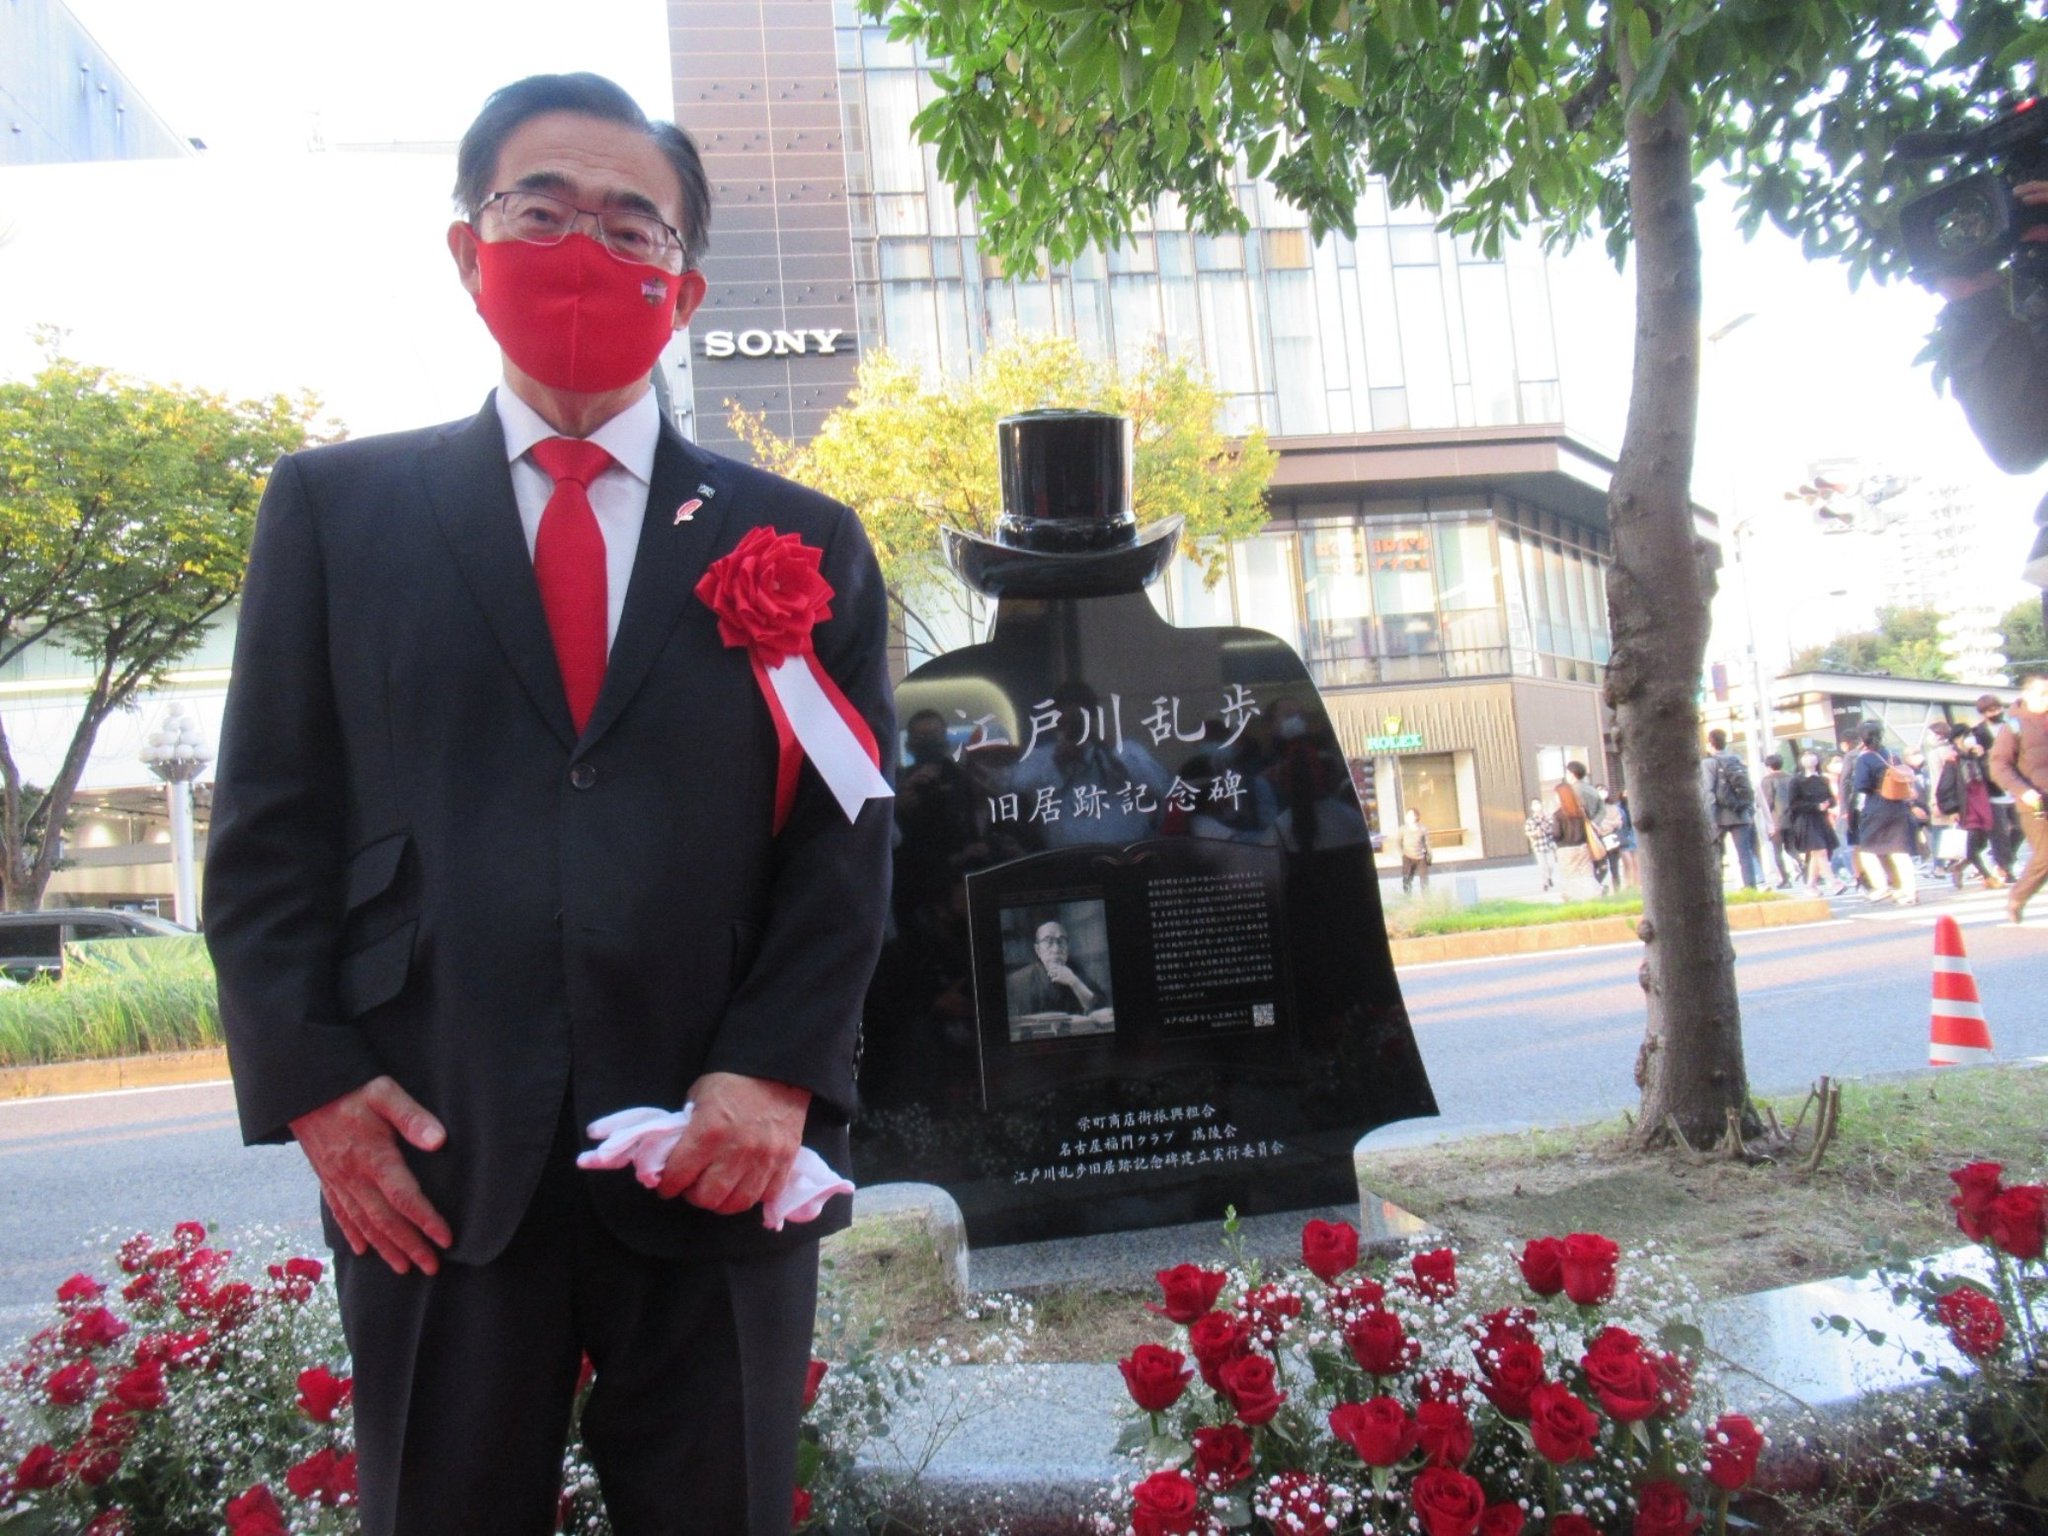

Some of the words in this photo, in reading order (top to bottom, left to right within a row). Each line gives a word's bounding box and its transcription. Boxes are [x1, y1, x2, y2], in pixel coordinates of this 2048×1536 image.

[705, 328, 843, 356] SONY
[952, 683, 1262, 763] 江戸川乱歩
[1367, 734, 1422, 751] ROLEX
[987, 769, 1248, 825] 旧居跡記念碑
[1014, 1140, 1285, 1185] 江戸川乱歩旧居跡記念碑建立実行委員会
